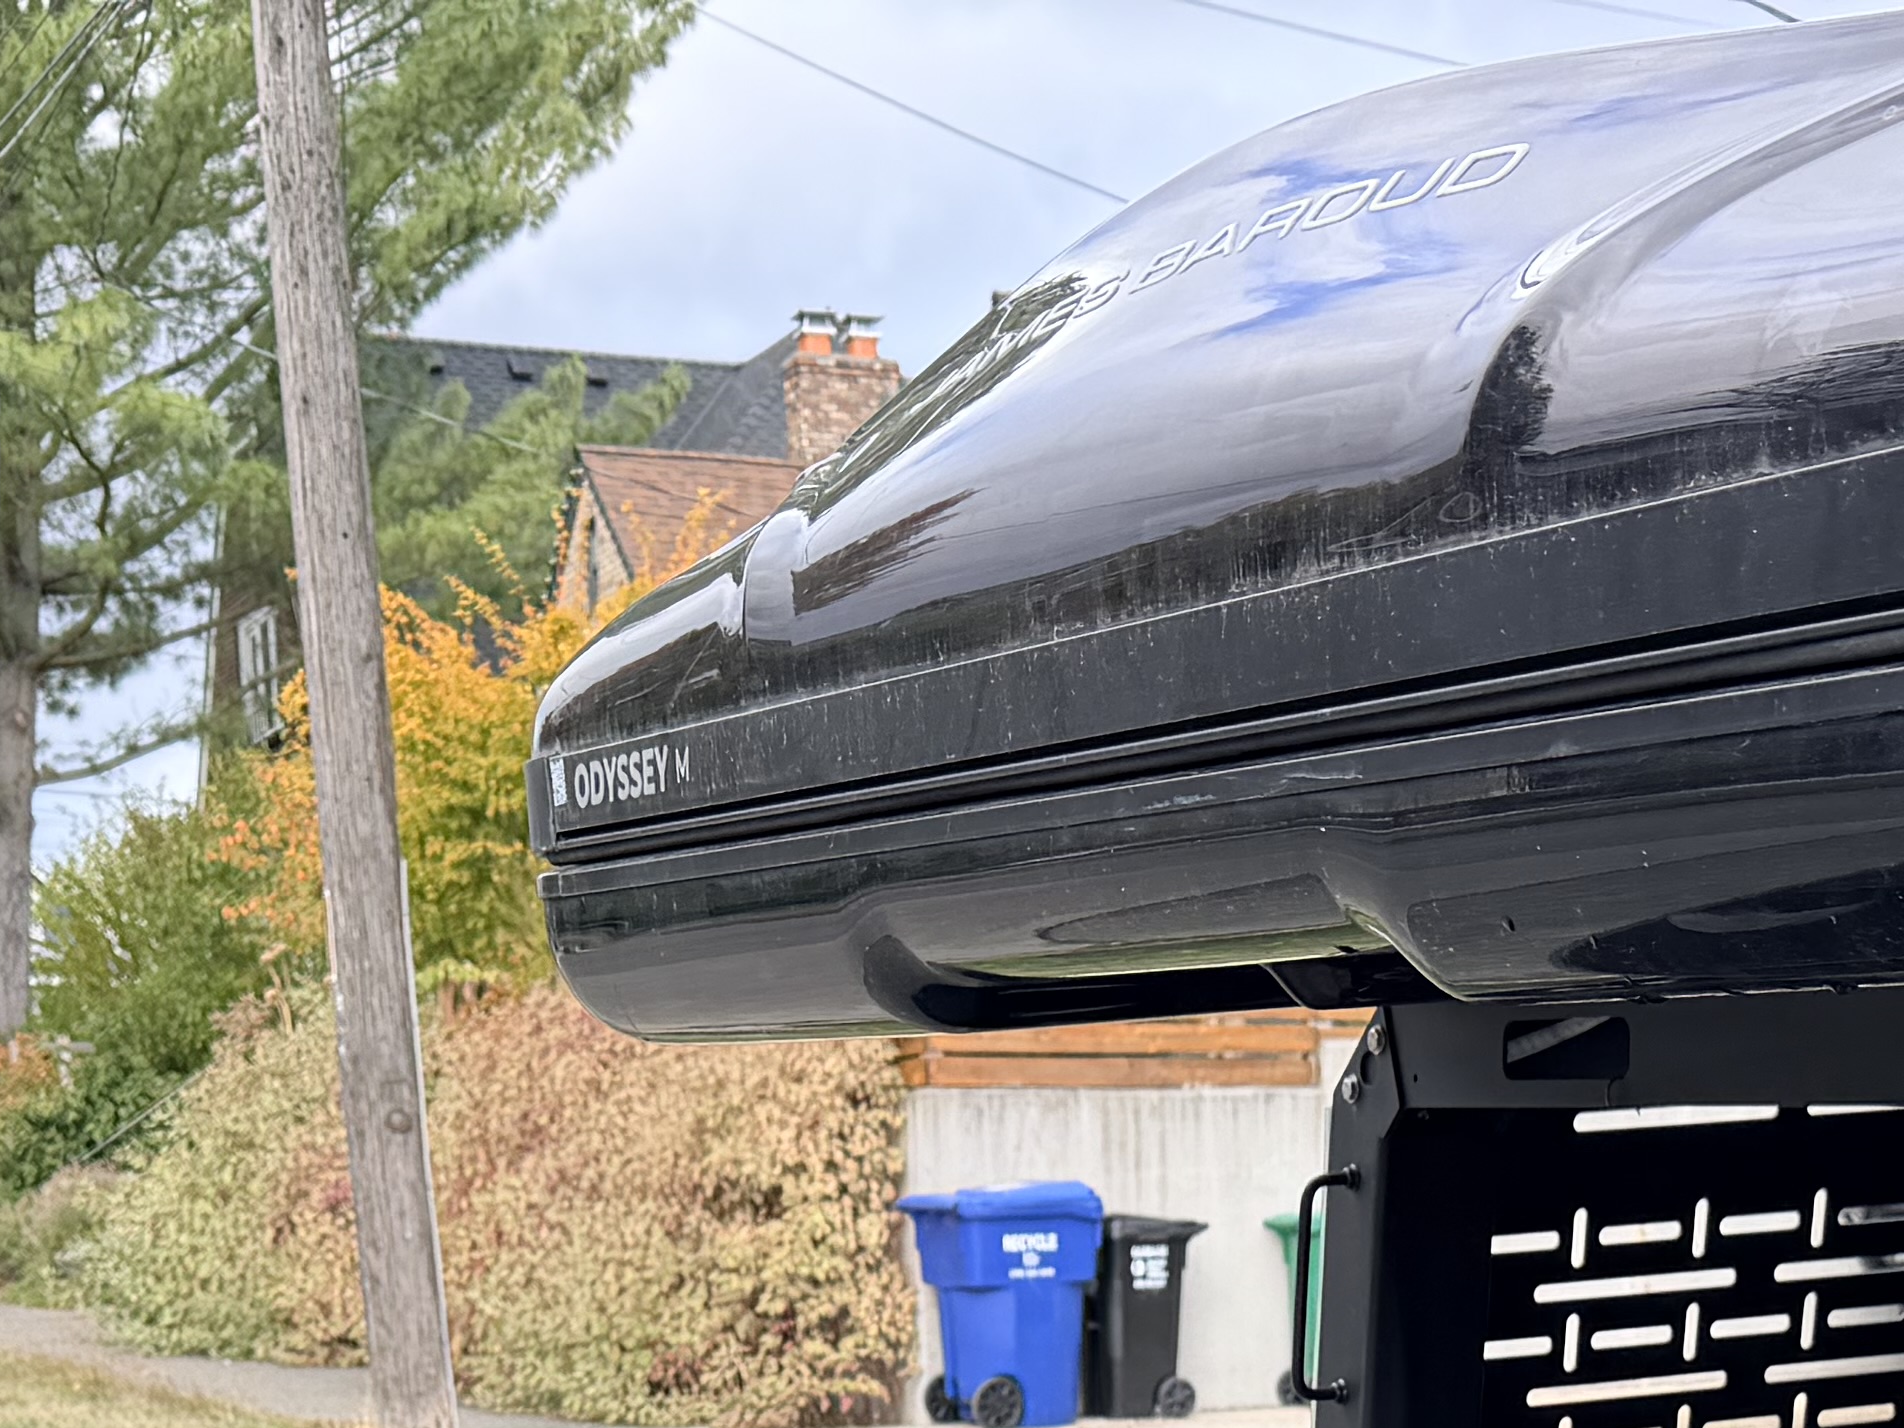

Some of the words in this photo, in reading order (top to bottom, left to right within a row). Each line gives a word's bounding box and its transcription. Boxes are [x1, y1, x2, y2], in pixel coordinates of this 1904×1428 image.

[1129, 142, 1531, 295] BAROUD
[574, 744, 669, 809] ODYSSEY
[675, 746, 691, 783] M
